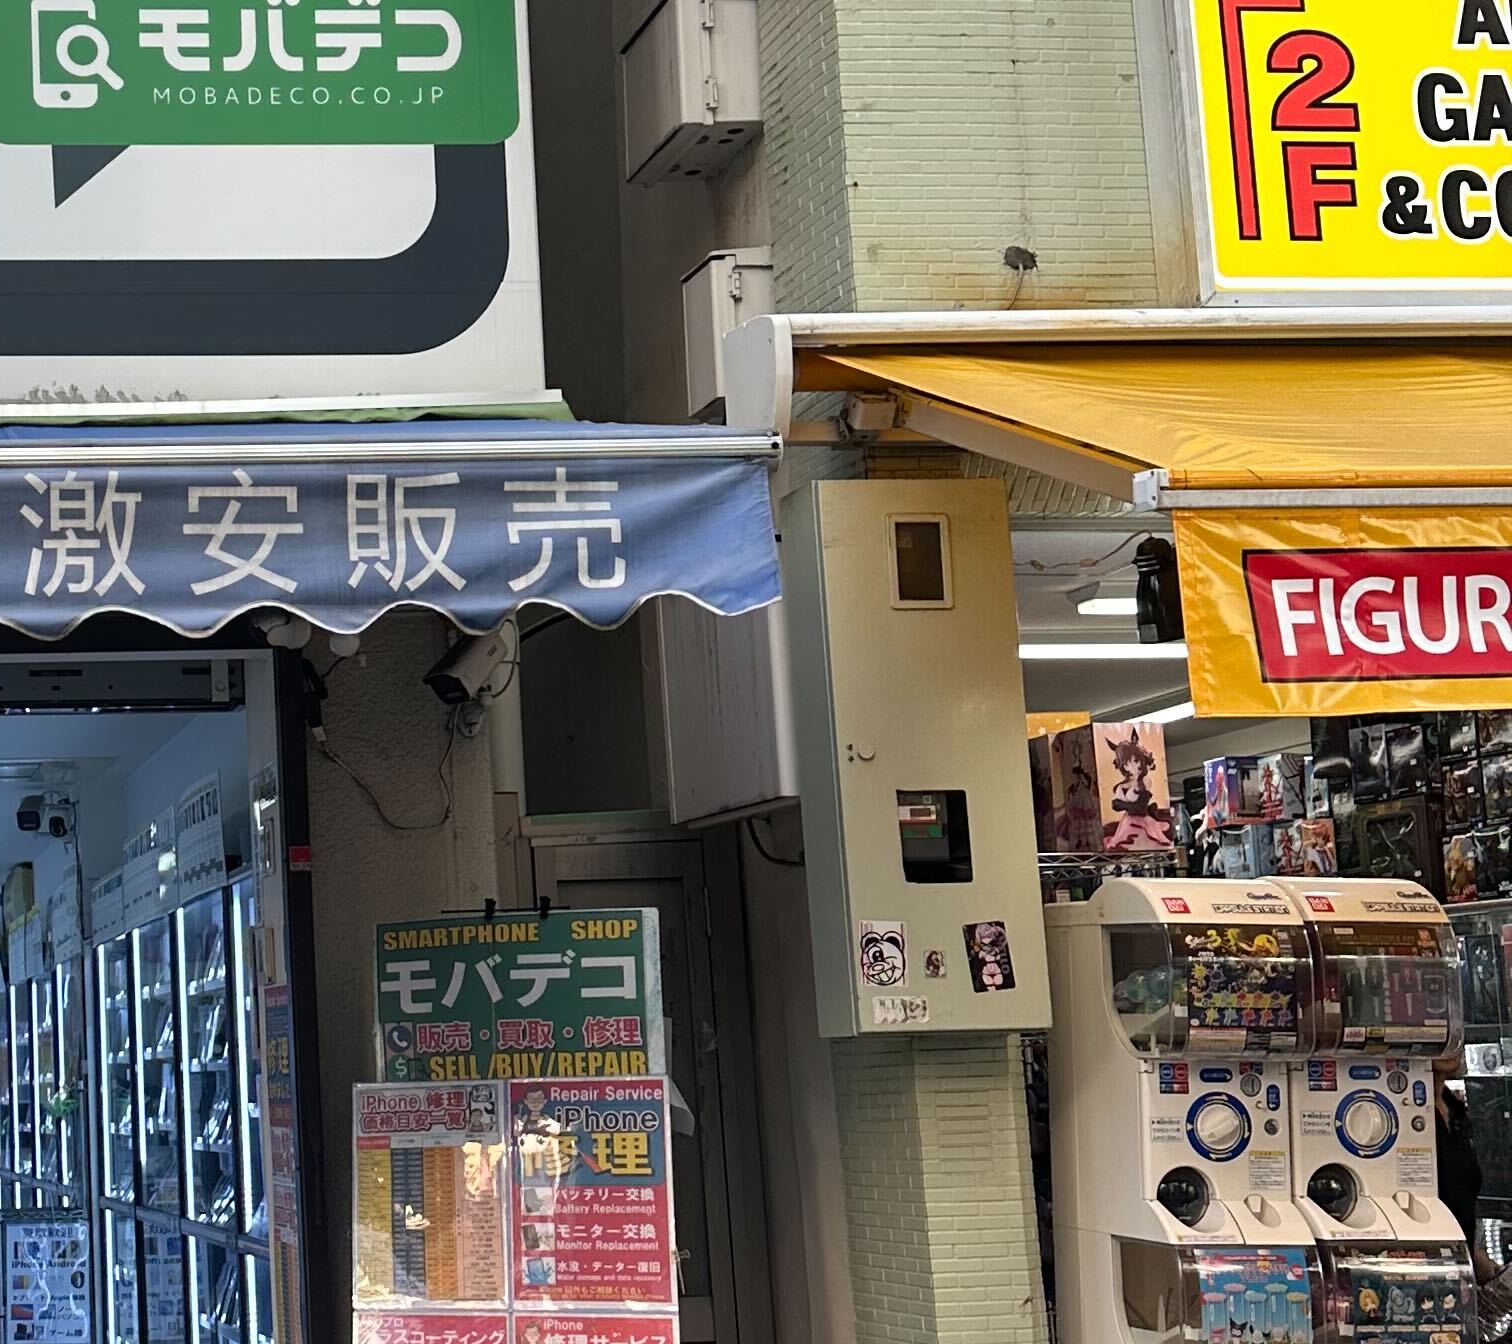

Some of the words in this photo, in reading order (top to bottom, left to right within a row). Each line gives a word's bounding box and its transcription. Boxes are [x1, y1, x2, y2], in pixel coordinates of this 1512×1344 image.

[152, 85, 448, 107] MOBADECO.CO.JP
[1267, 28, 1361, 243] 2F
[18, 466, 628, 598] 激安販売
[382, 921, 540, 952] SMARTPHONE
[570, 918, 639, 941] SHOP
[380, 948, 638, 1015] モバデコ
[550, 1086, 600, 1103] Repair
[605, 1085, 663, 1101] Service
[554, 1106, 660, 1133] iPhone
[556, 1223, 657, 1239] モニター交換
[543, 1318, 585, 1331] iPhone
